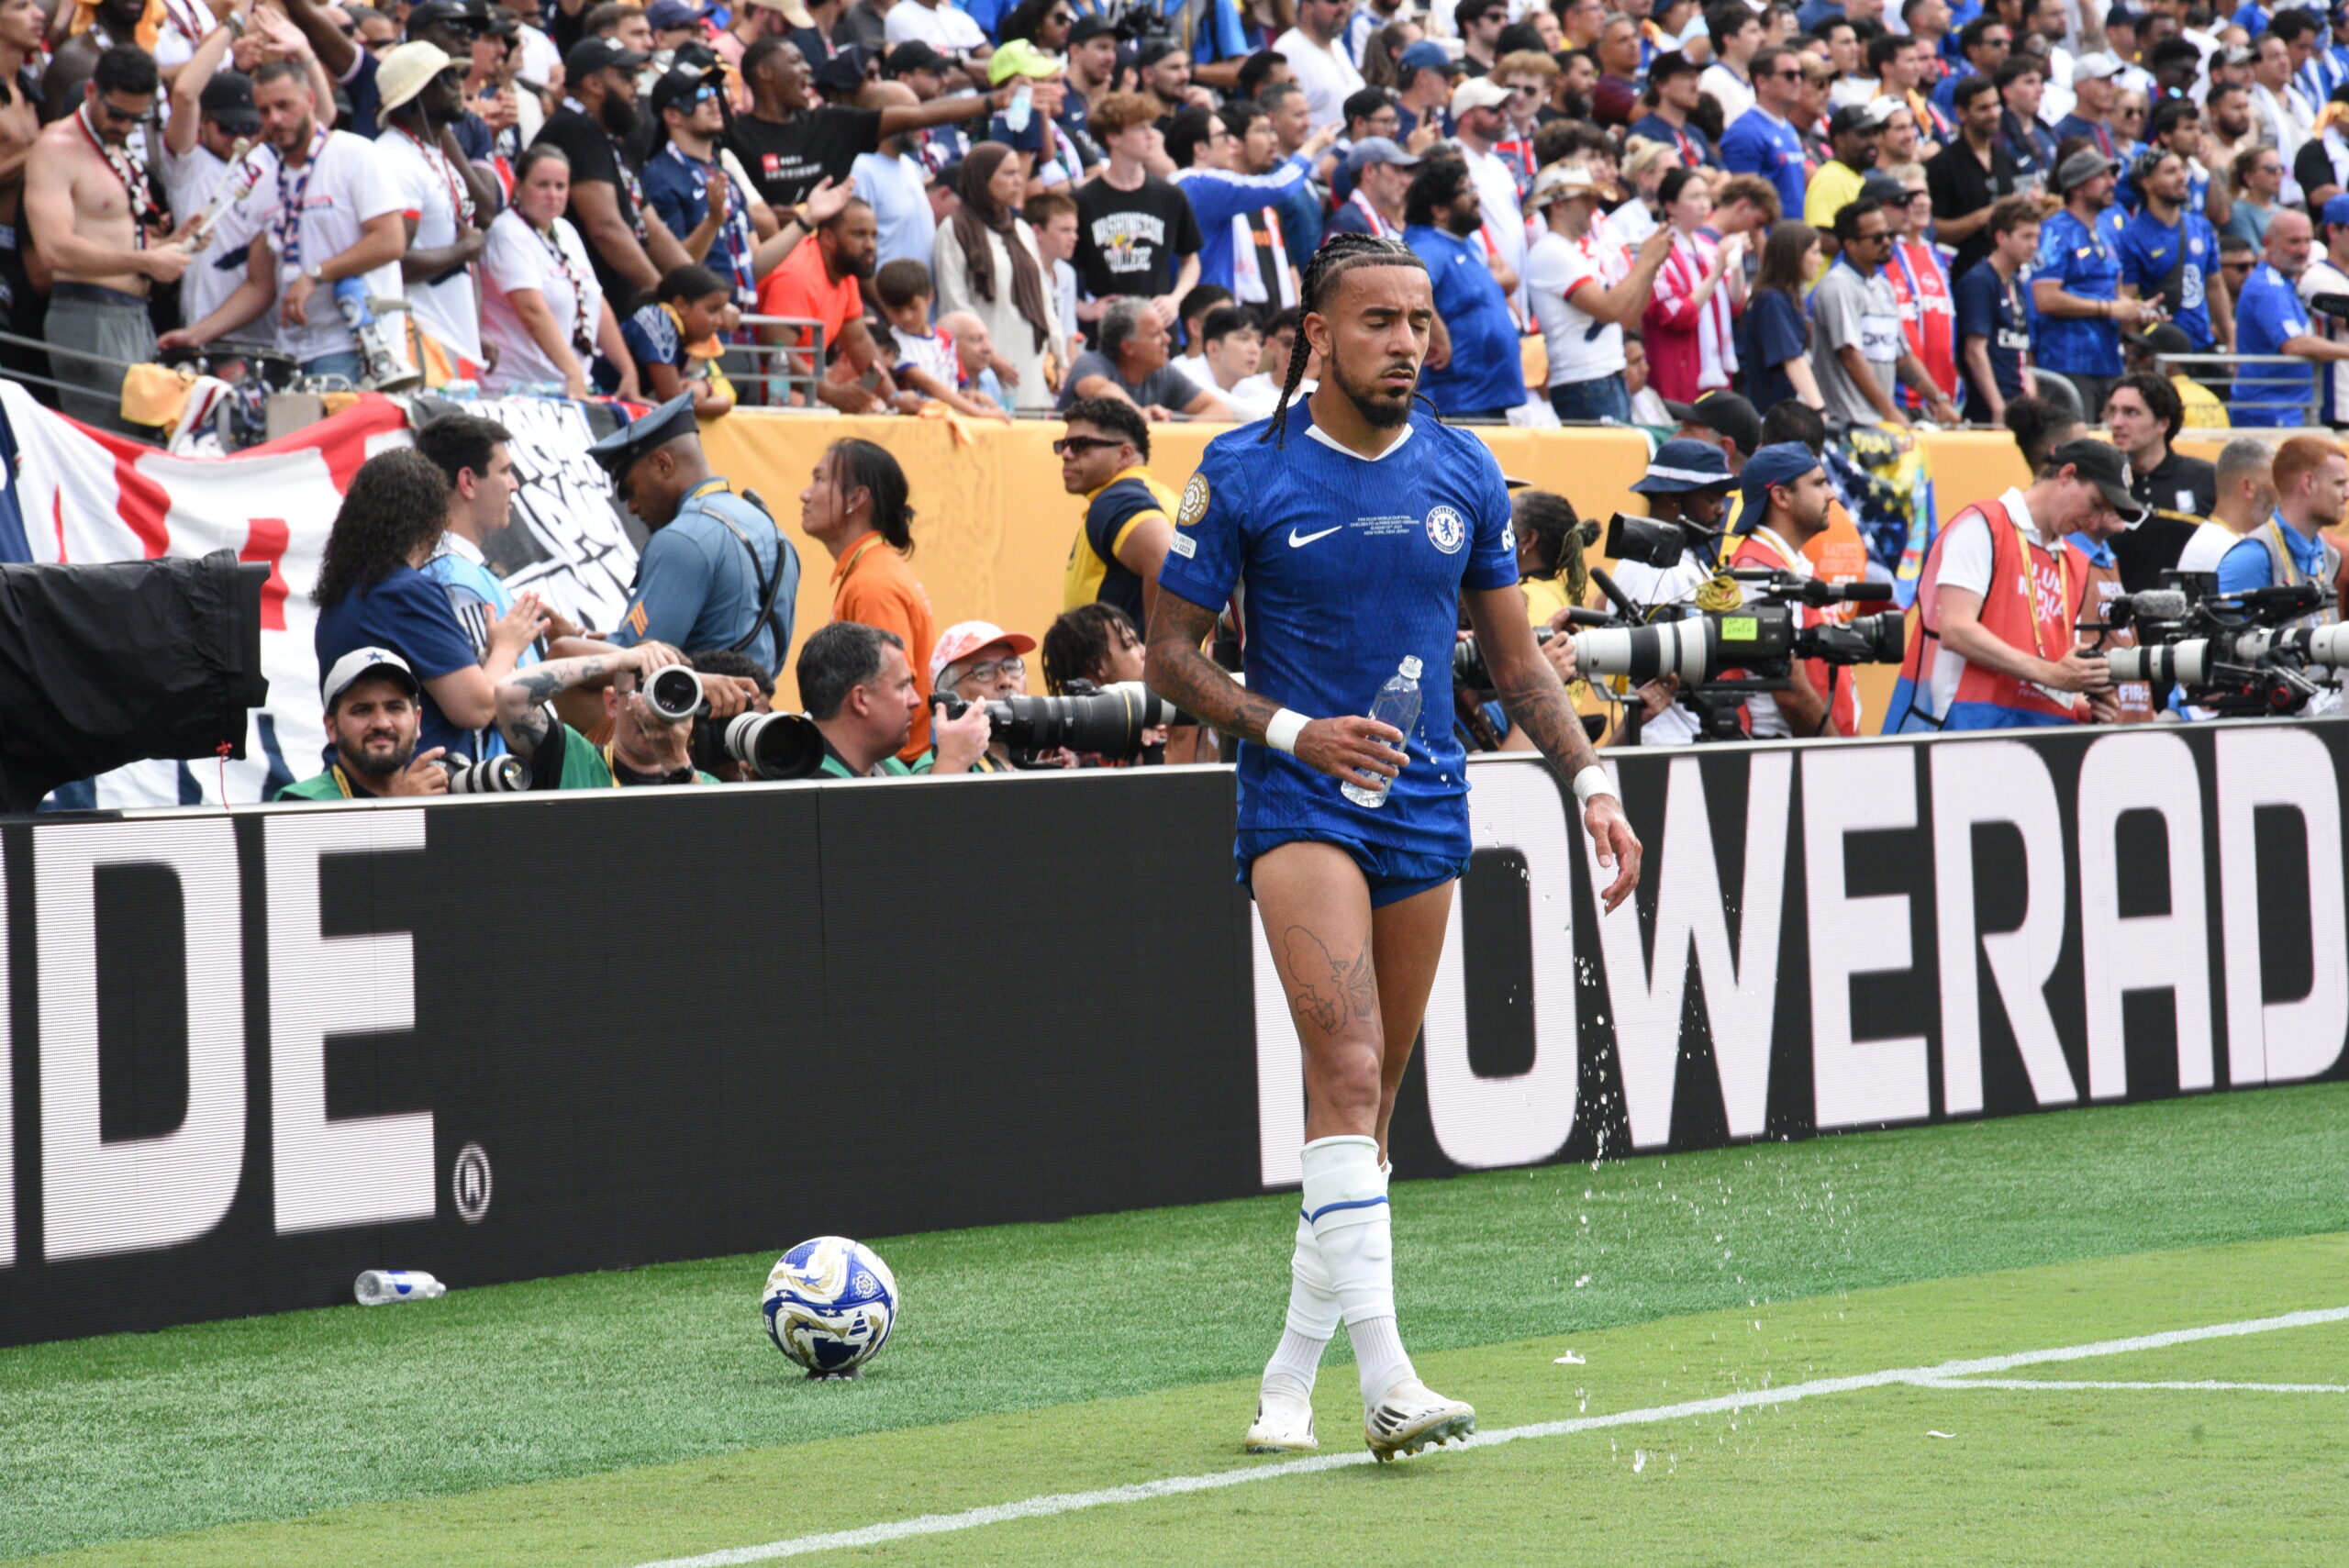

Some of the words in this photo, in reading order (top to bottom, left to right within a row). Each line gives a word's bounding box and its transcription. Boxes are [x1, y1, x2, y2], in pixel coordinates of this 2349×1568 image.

[1091, 211, 1164, 247] WASHINGTON
[1104, 246, 1152, 272] COLLEGE
[1431, 507, 1456, 518] CHELSEA
[1250, 728, 2349, 1188] OWERAD
